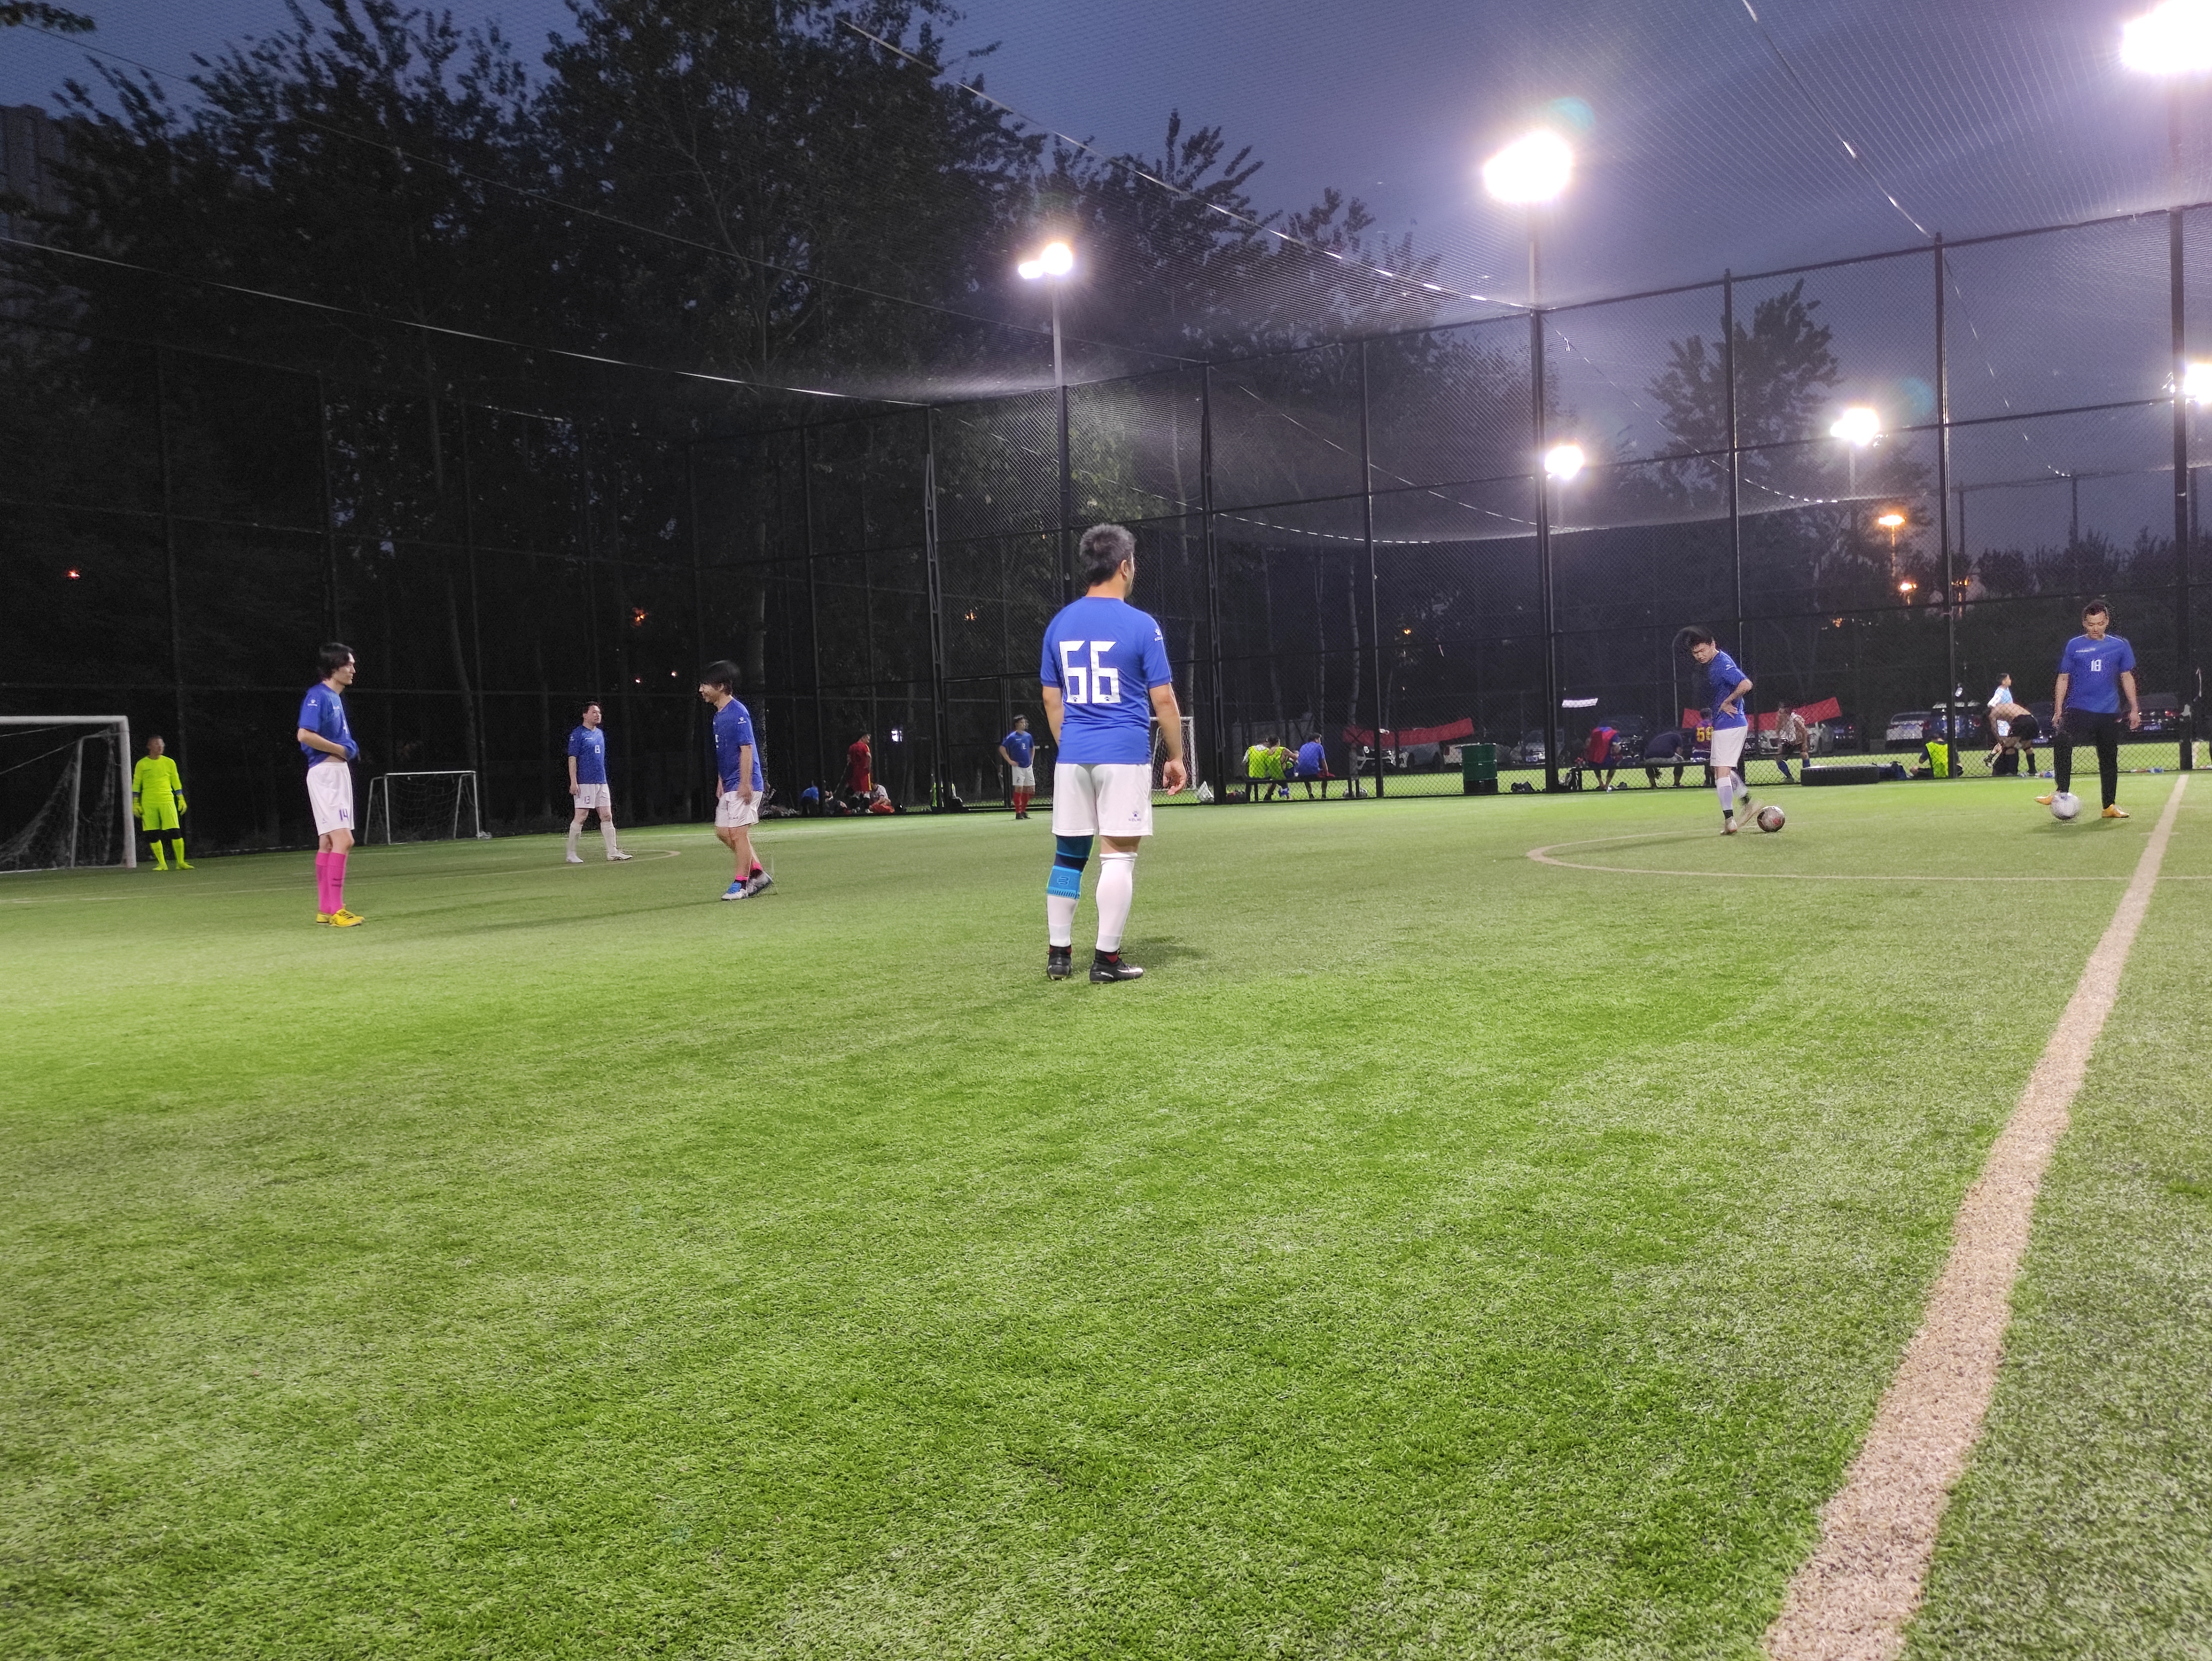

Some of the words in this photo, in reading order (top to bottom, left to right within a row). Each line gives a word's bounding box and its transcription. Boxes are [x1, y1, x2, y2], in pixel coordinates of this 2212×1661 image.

[1059, 640, 1121, 704] 66
[2090, 659, 2102, 672] 18
[339, 808, 349, 821] 14
